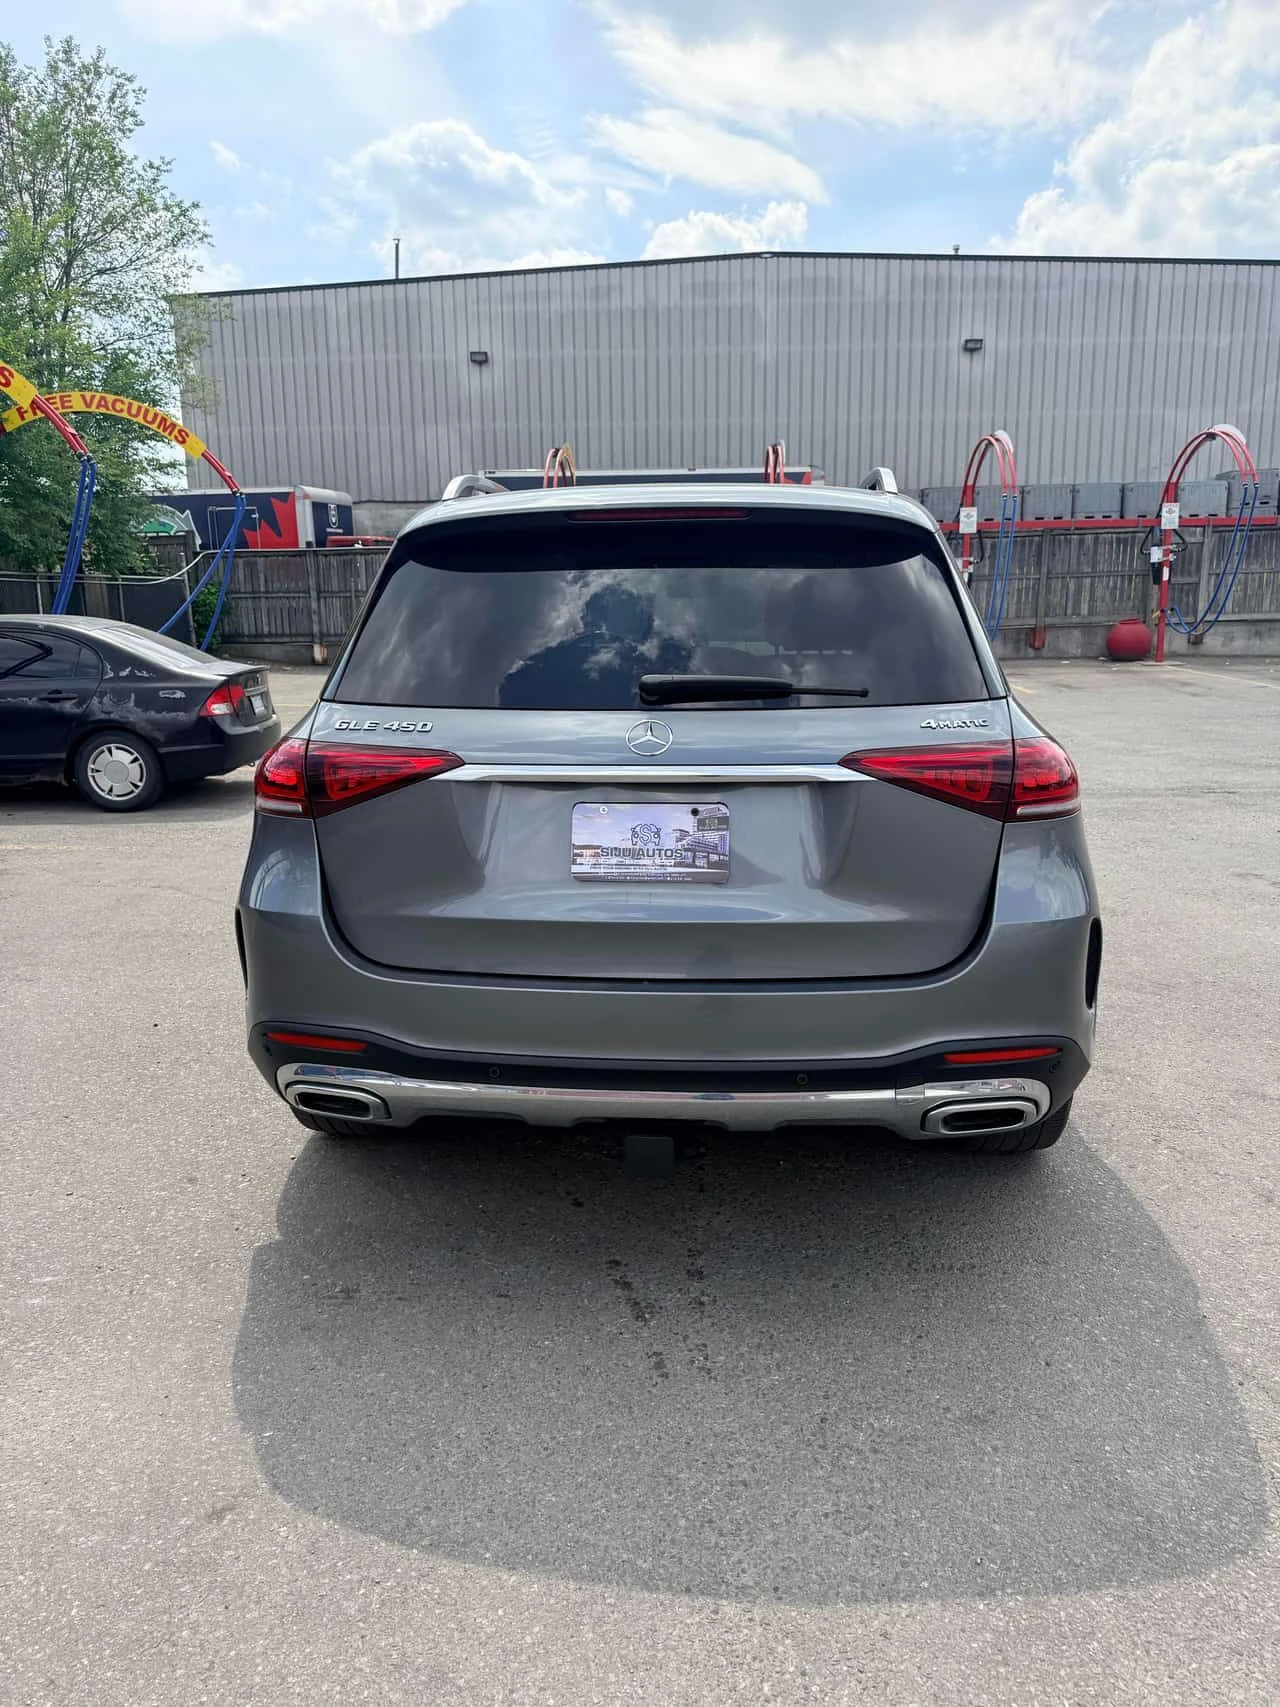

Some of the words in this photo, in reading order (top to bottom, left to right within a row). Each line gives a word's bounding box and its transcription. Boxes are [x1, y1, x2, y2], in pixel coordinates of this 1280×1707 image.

[79, 394, 190, 445] VACUUMS
[334, 719, 380, 731] GLE
[383, 720, 433, 733] 450
[920, 718, 989, 730] 4MATIC
[636, 847, 683, 858] AUTOS
